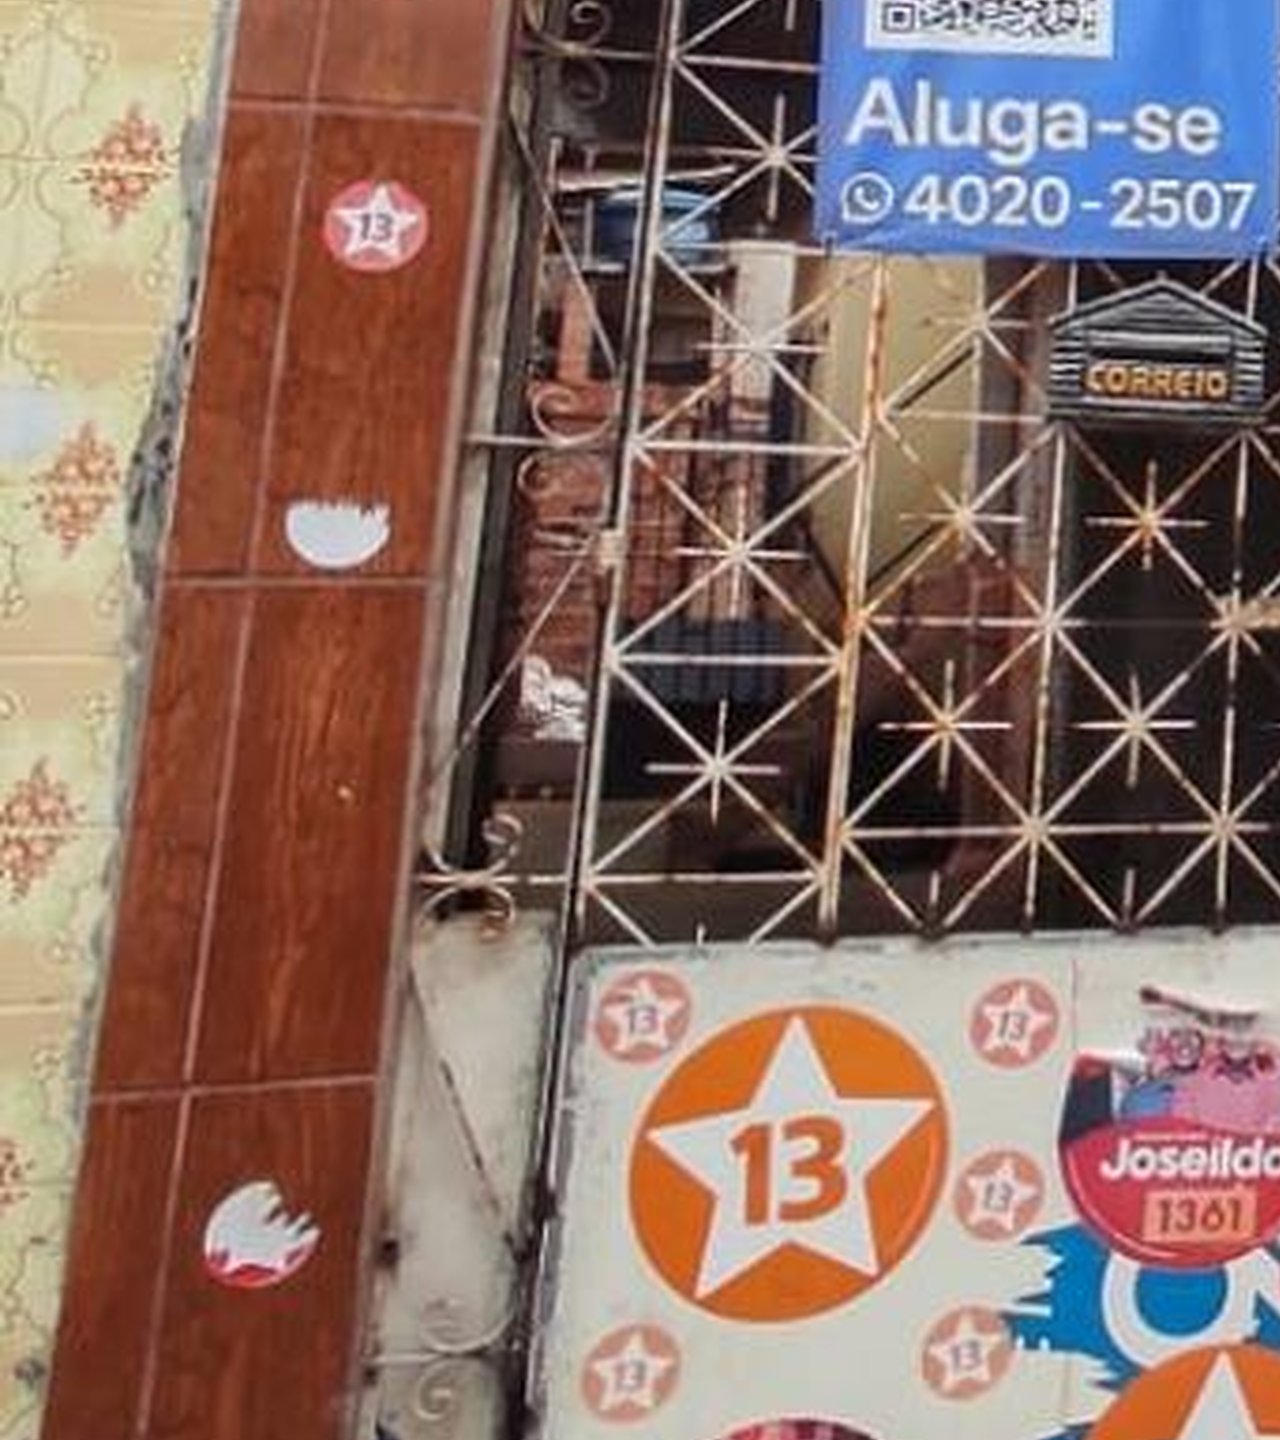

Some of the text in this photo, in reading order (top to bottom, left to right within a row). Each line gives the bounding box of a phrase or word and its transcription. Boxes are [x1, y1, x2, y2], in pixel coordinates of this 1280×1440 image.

[845, 76, 1222, 167] Aluga-se
[359, 212, 393, 245] 13
[1085, 364, 1229, 399] CORREIO
[628, 1003, 658, 1034] 13
[998, 1010, 1027, 1043] 13
[729, 1115, 849, 1227] 13
[982, 1183, 1013, 1212] 13
[1158, 1197, 1243, 1234] 1361
[950, 1341, 983, 1371] 13
[613, 1361, 648, 1392] 13
